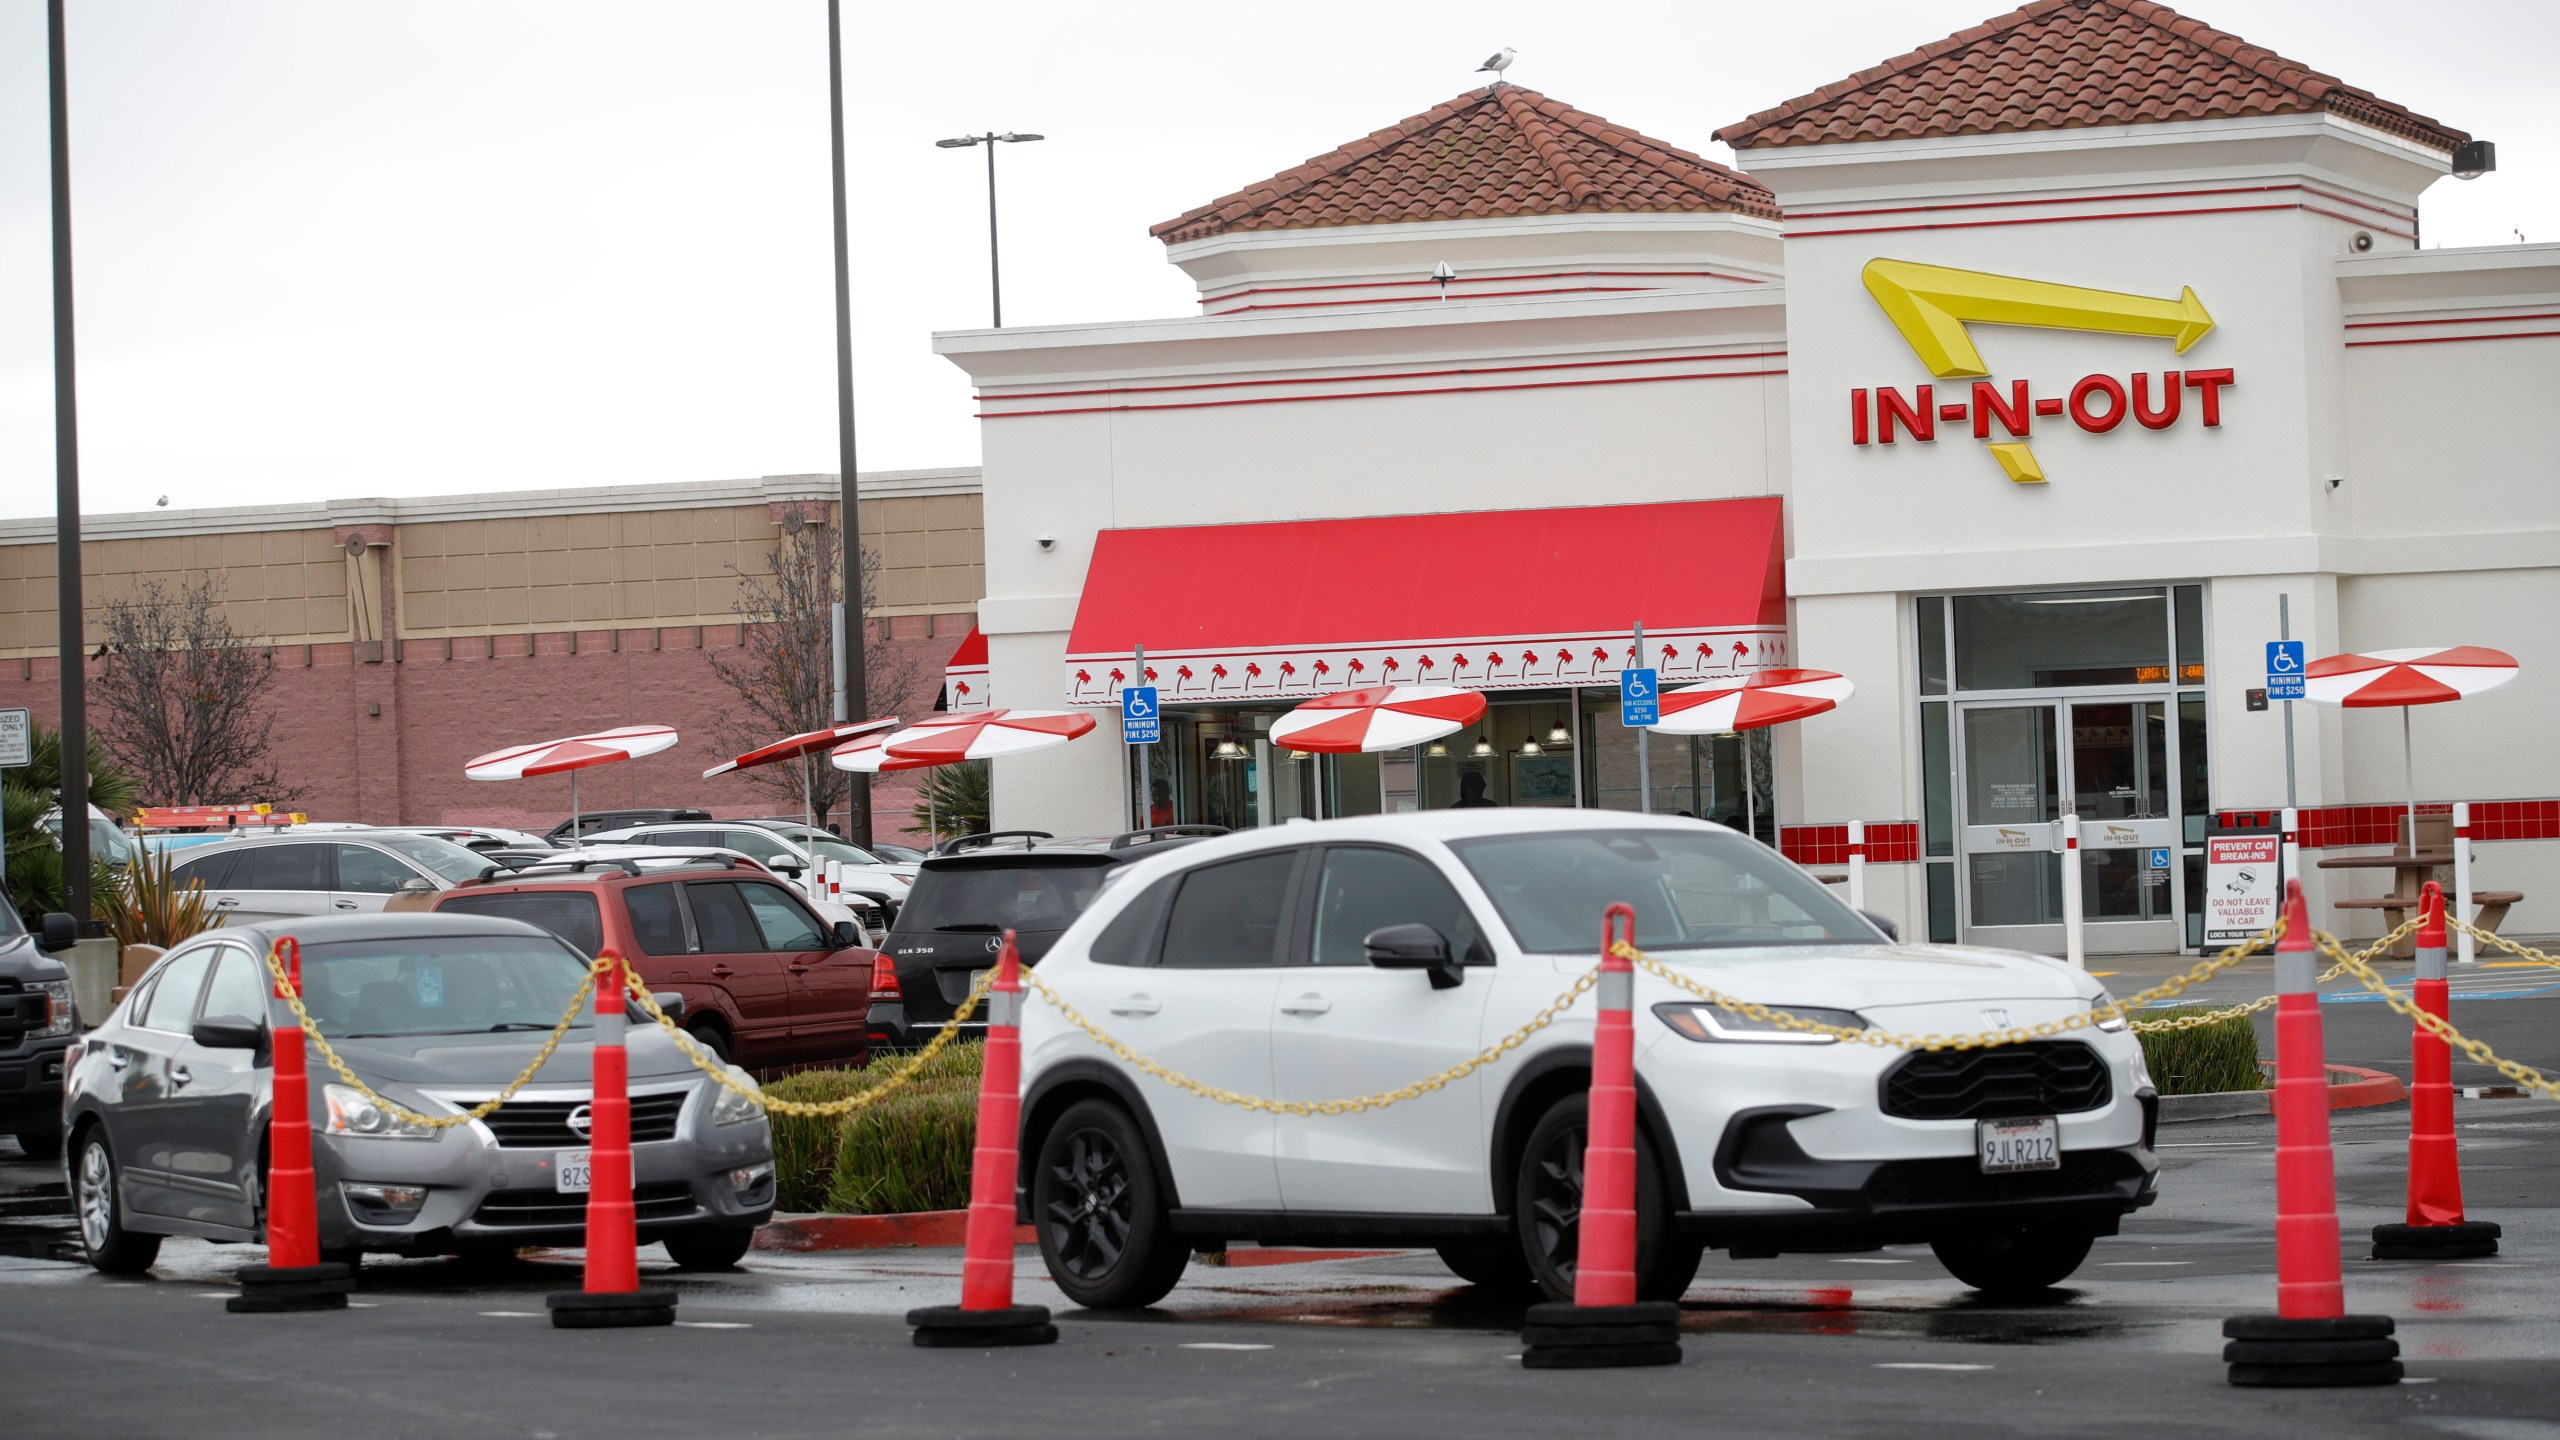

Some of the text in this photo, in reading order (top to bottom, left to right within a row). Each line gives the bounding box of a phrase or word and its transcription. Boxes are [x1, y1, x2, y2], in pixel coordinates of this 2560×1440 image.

[1851, 368, 2235, 446] IN-N-OUT
[2270, 676, 2301, 685] MINIMUM
[2268, 686, 2304, 695] FINE $250
[2, 723, 24, 731] ONLY
[1127, 721, 1155, 729] MINIMUM
[1126, 729, 1158, 738] FINE $250
[2213, 842, 2273, 851] PREVENT CAR
[2220, 852, 2266, 860] BREAK-INS
[2212, 899, 2224, 907] DO
[2246, 898, 2271, 906] LEAVE
[2217, 908, 2264, 916] VALUABLES
[2237, 917, 2255, 925] CAR
[1986, 1138, 2053, 1164] 9JLR212
